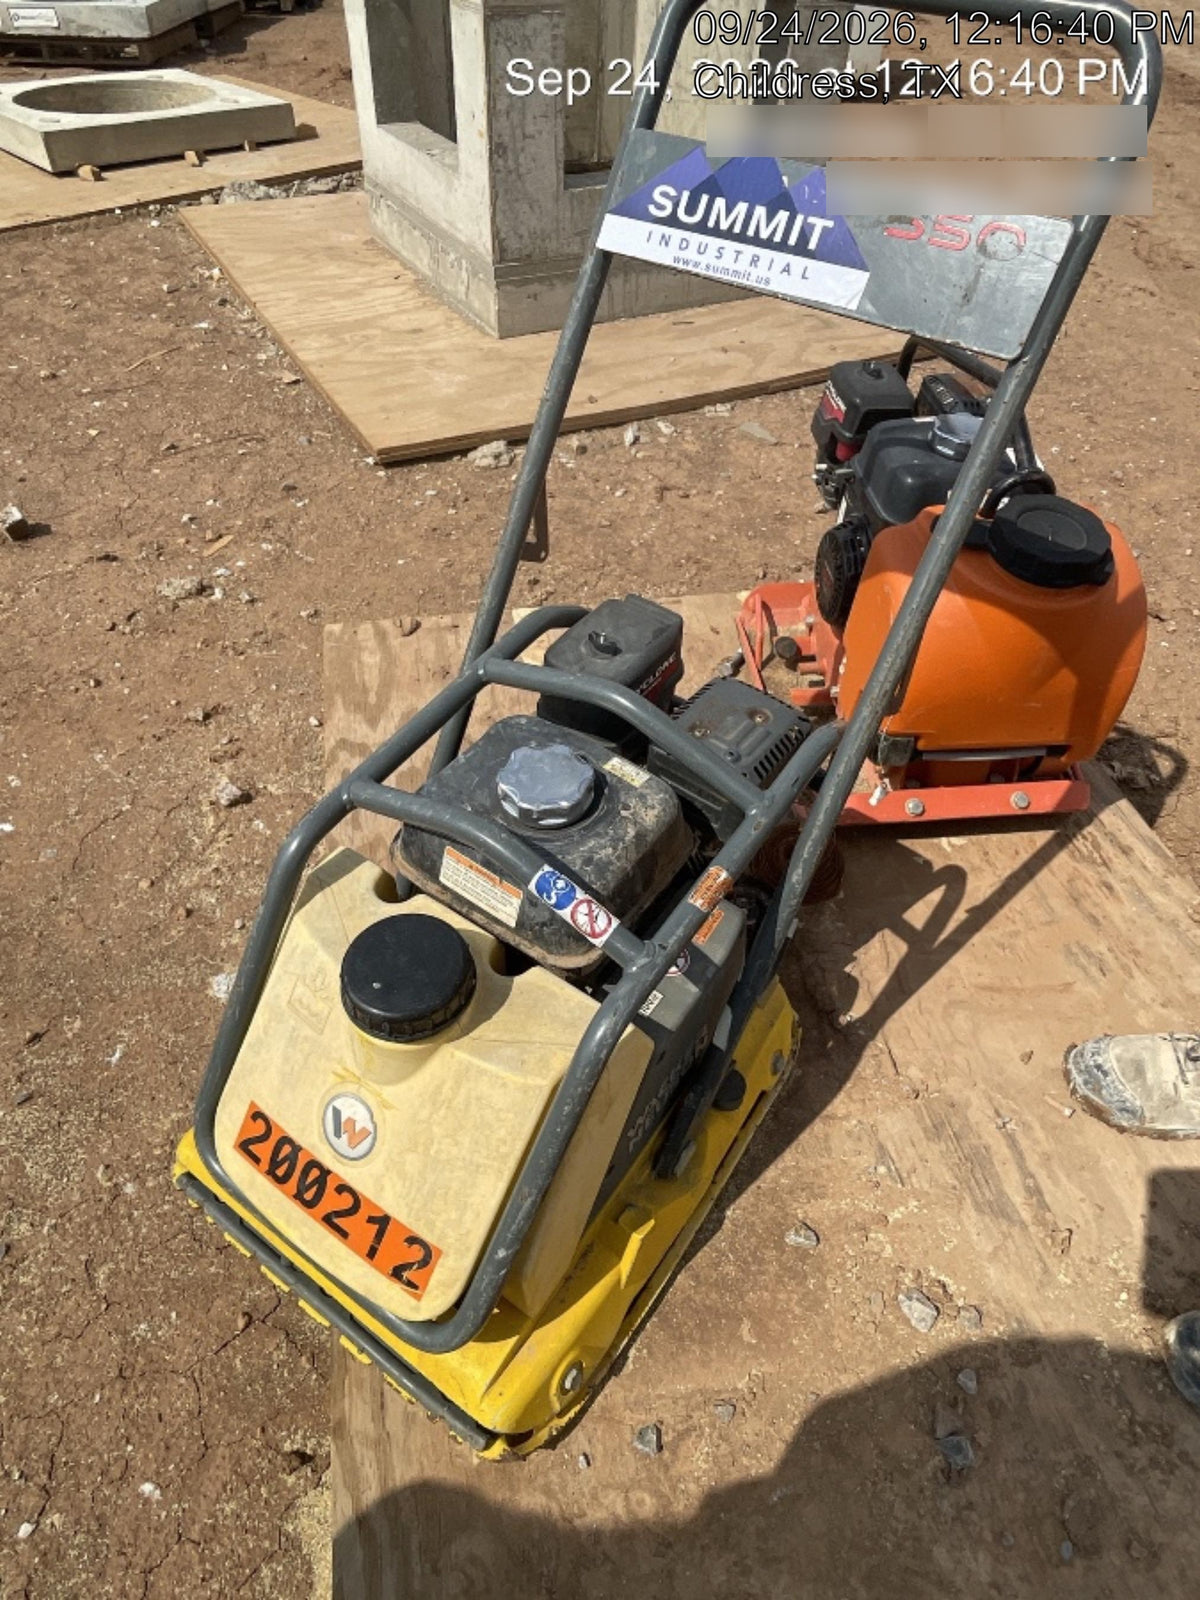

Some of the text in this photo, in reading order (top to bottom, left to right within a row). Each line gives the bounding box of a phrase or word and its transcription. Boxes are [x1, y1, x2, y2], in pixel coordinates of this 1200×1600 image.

[648, 184, 834, 251] SUMMIT
[646, 230, 810, 281] INDUSTRIAL
[673, 254, 772, 287] www.summit.us
[238, 1110, 433, 1291] 200212
